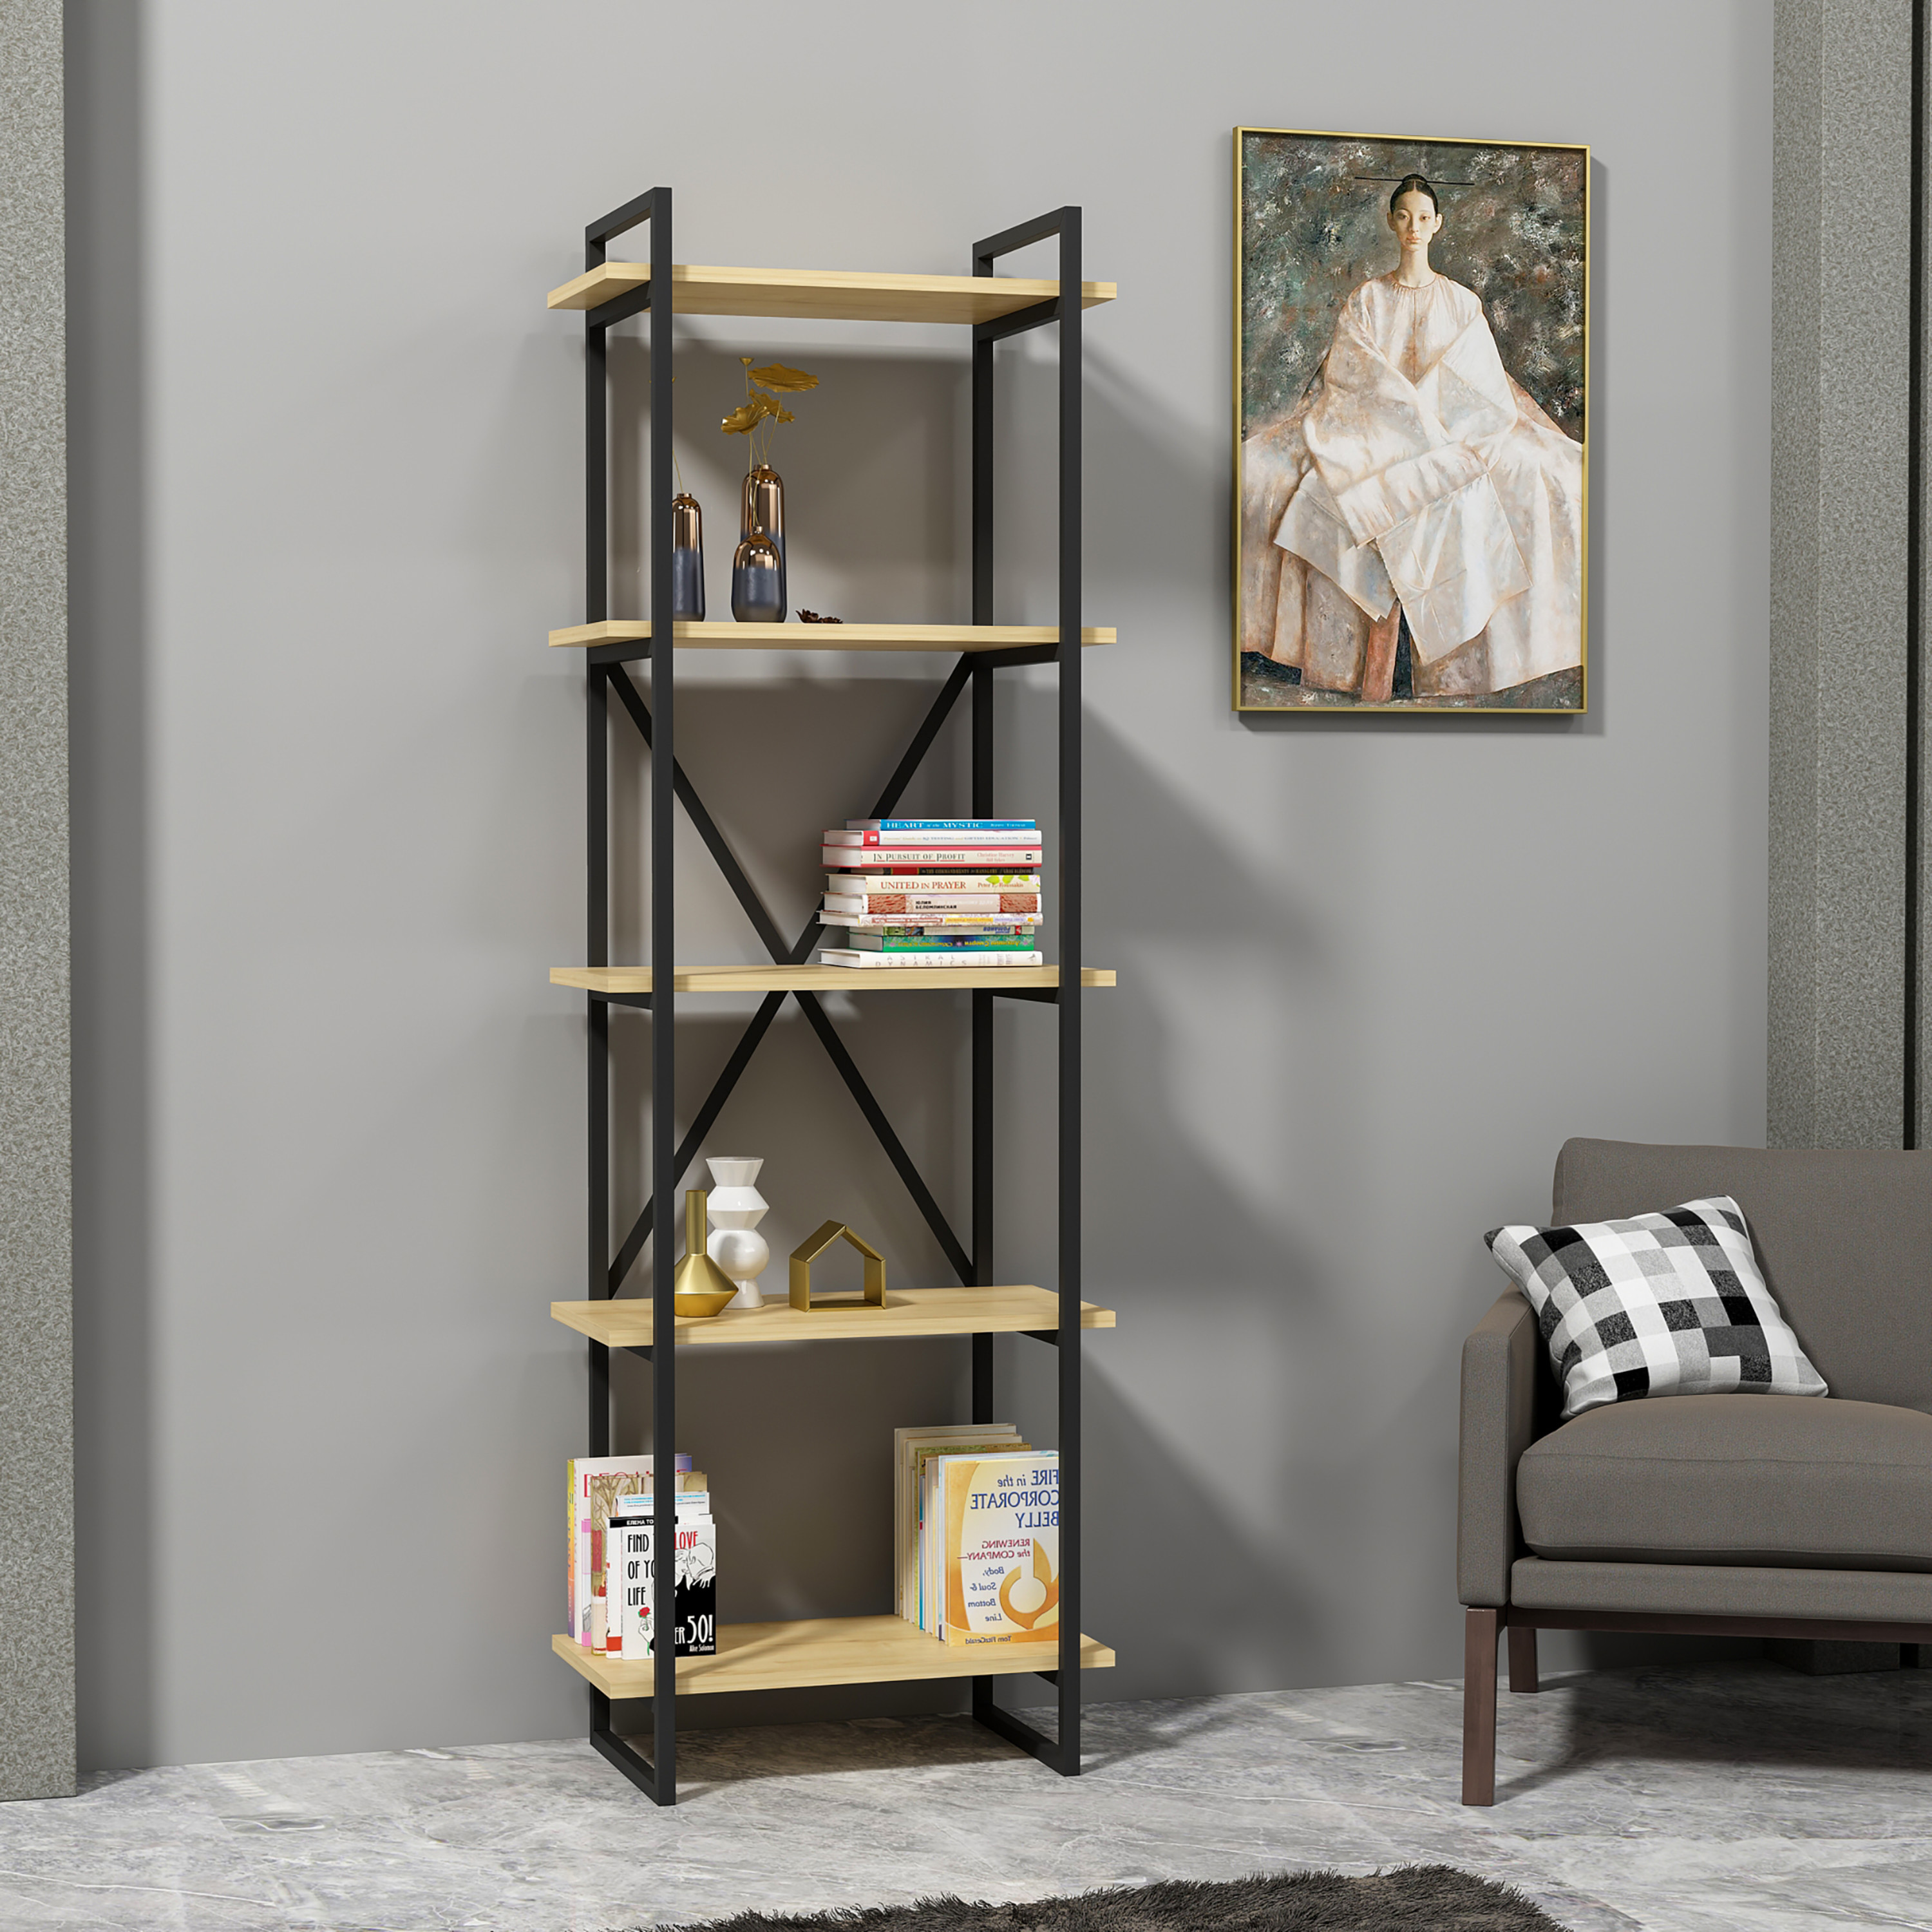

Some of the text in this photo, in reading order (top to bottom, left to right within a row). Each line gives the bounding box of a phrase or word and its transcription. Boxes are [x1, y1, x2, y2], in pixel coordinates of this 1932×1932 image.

[886, 853, 920, 862] PURSUIT
[936, 853, 965, 862] PROFIT
[627, 1534, 649, 1553] FIND
[627, 1560, 640, 1580] OF
[627, 1587, 646, 1605] LIFE
[687, 1614, 714, 1643] 50!
